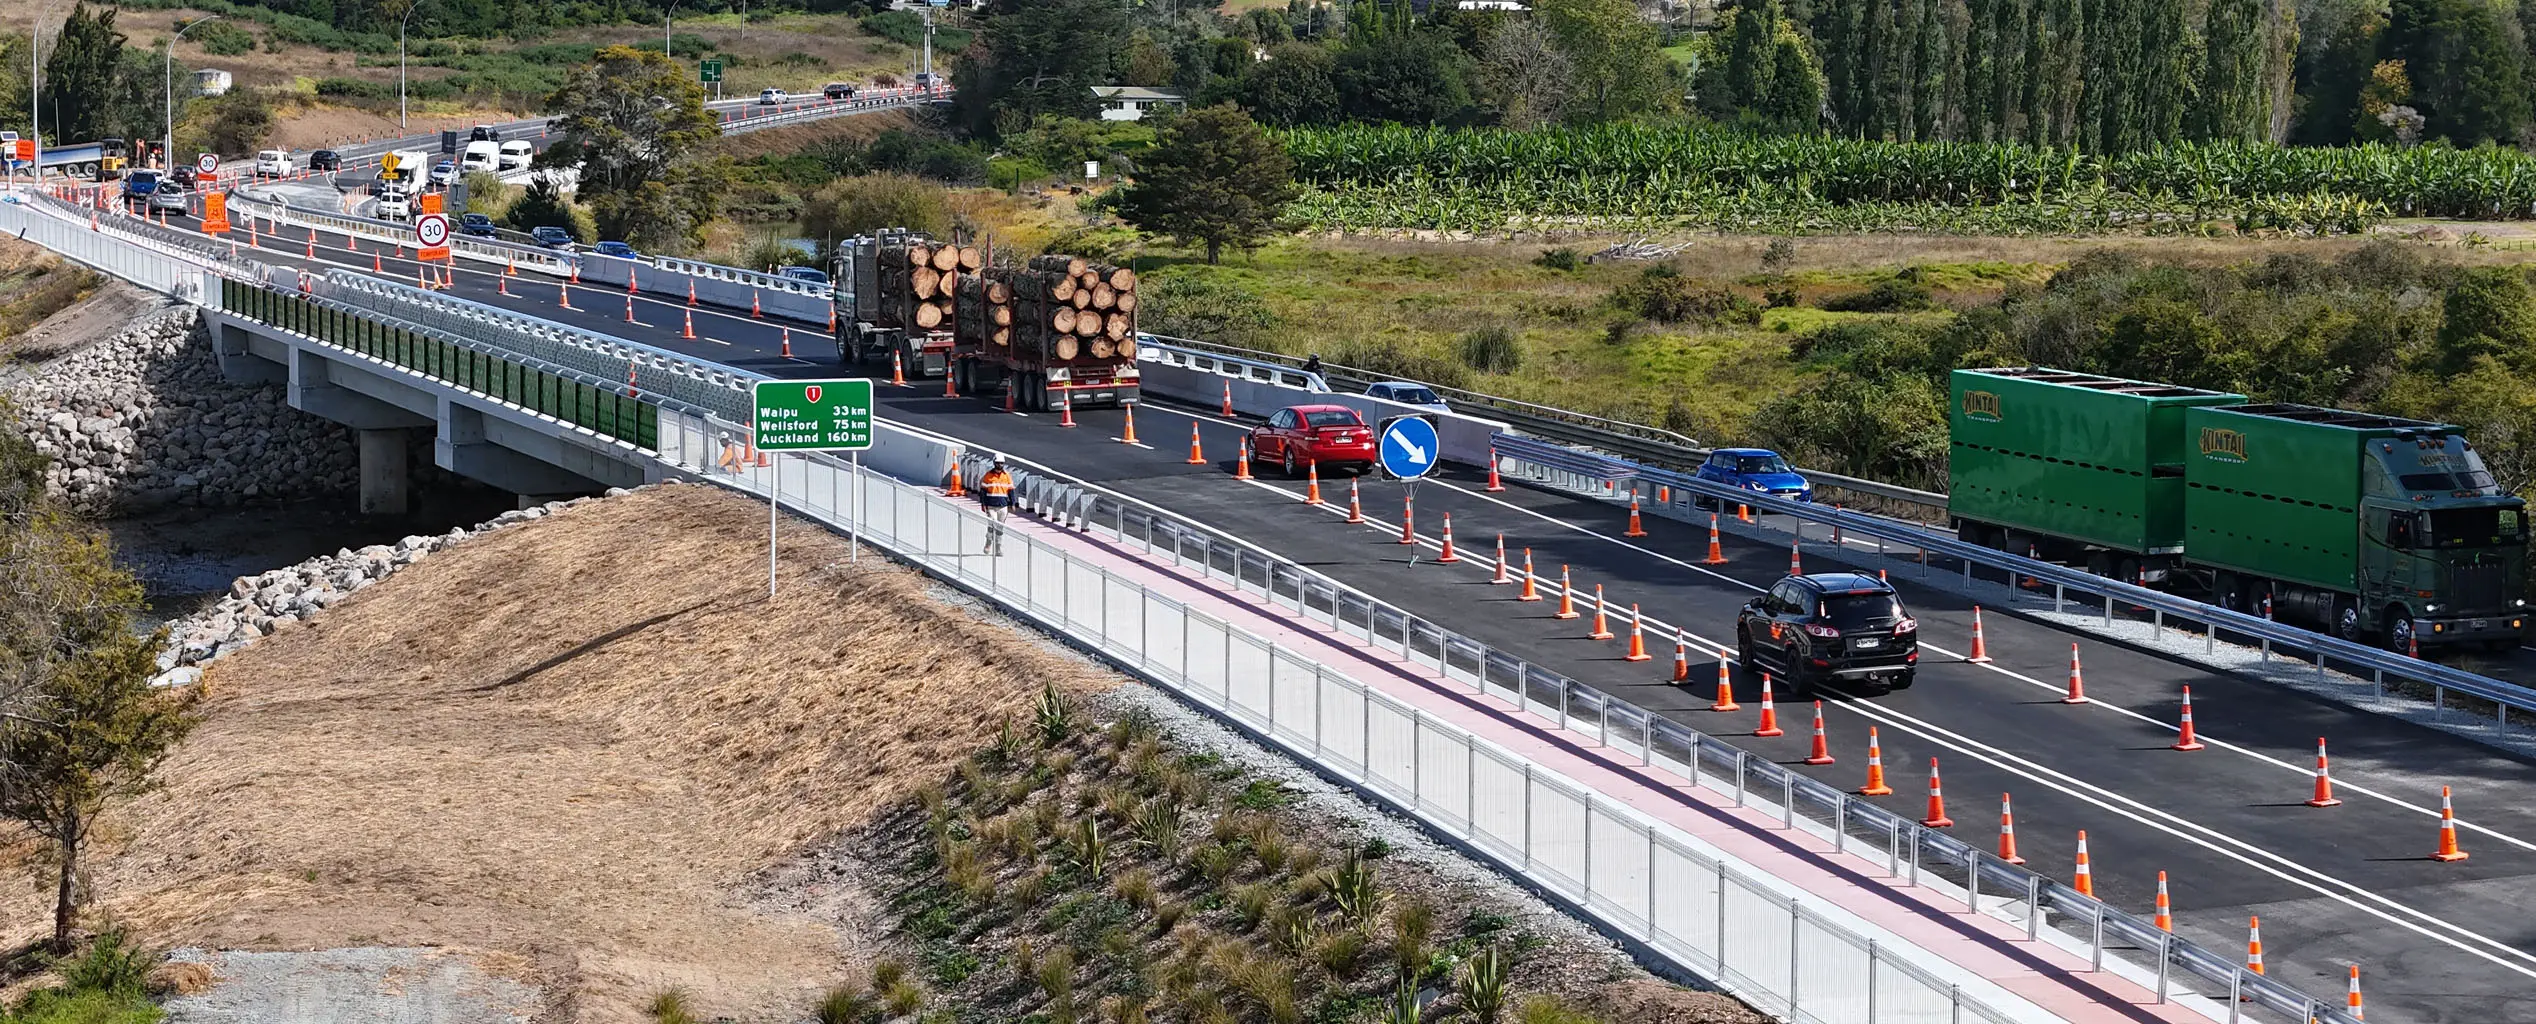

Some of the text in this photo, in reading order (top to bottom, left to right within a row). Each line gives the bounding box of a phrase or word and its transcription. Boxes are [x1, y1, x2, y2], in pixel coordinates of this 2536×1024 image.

[424, 224, 442, 237] 30
[812, 388, 816, 398] 1
[1962, 390, 2003, 420] KINTAIL
[760, 406, 867, 419] Waipu 33 km
[760, 419, 867, 431] Wellsford 75 km
[760, 432, 867, 444] Auckland 160 km
[2199, 427, 2248, 461] KINTAIL
[2205, 455, 2245, 464] TRANSPORT
